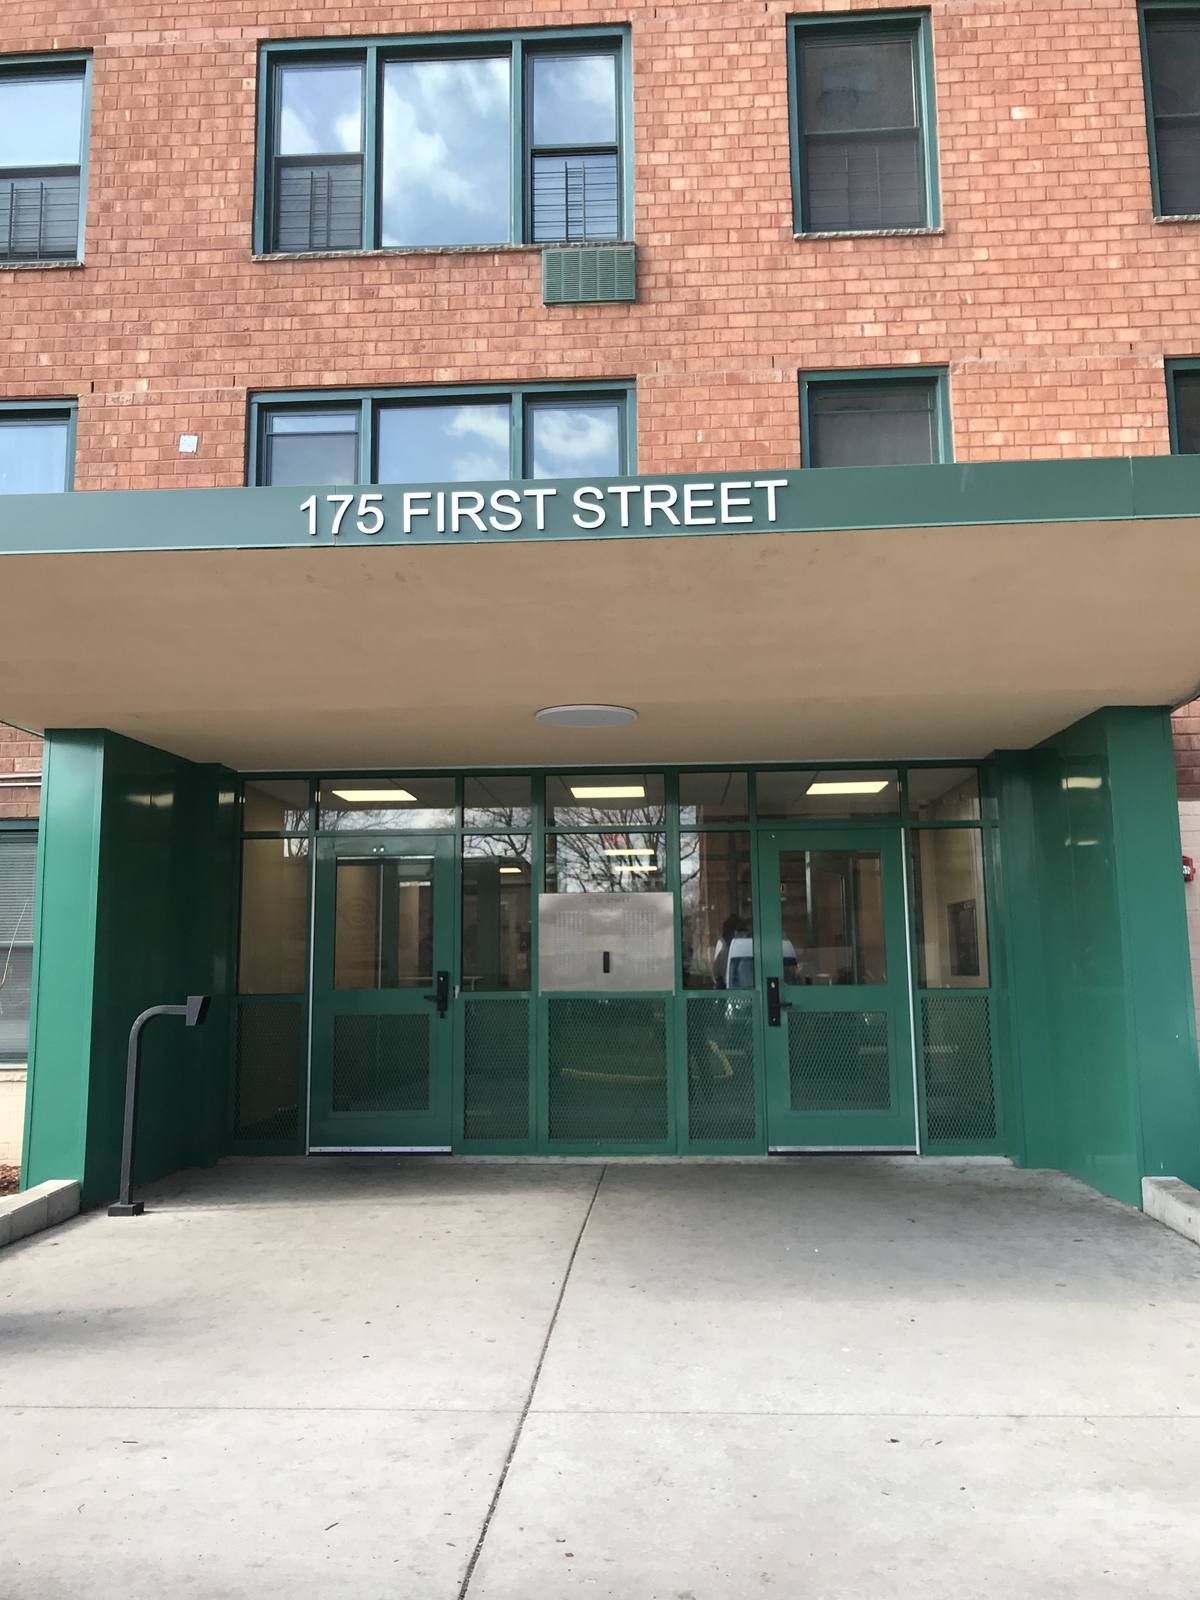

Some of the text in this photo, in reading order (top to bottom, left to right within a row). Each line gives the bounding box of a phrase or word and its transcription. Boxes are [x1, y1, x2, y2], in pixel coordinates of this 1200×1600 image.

[299, 479, 788, 535] 175 FIRST STREET
